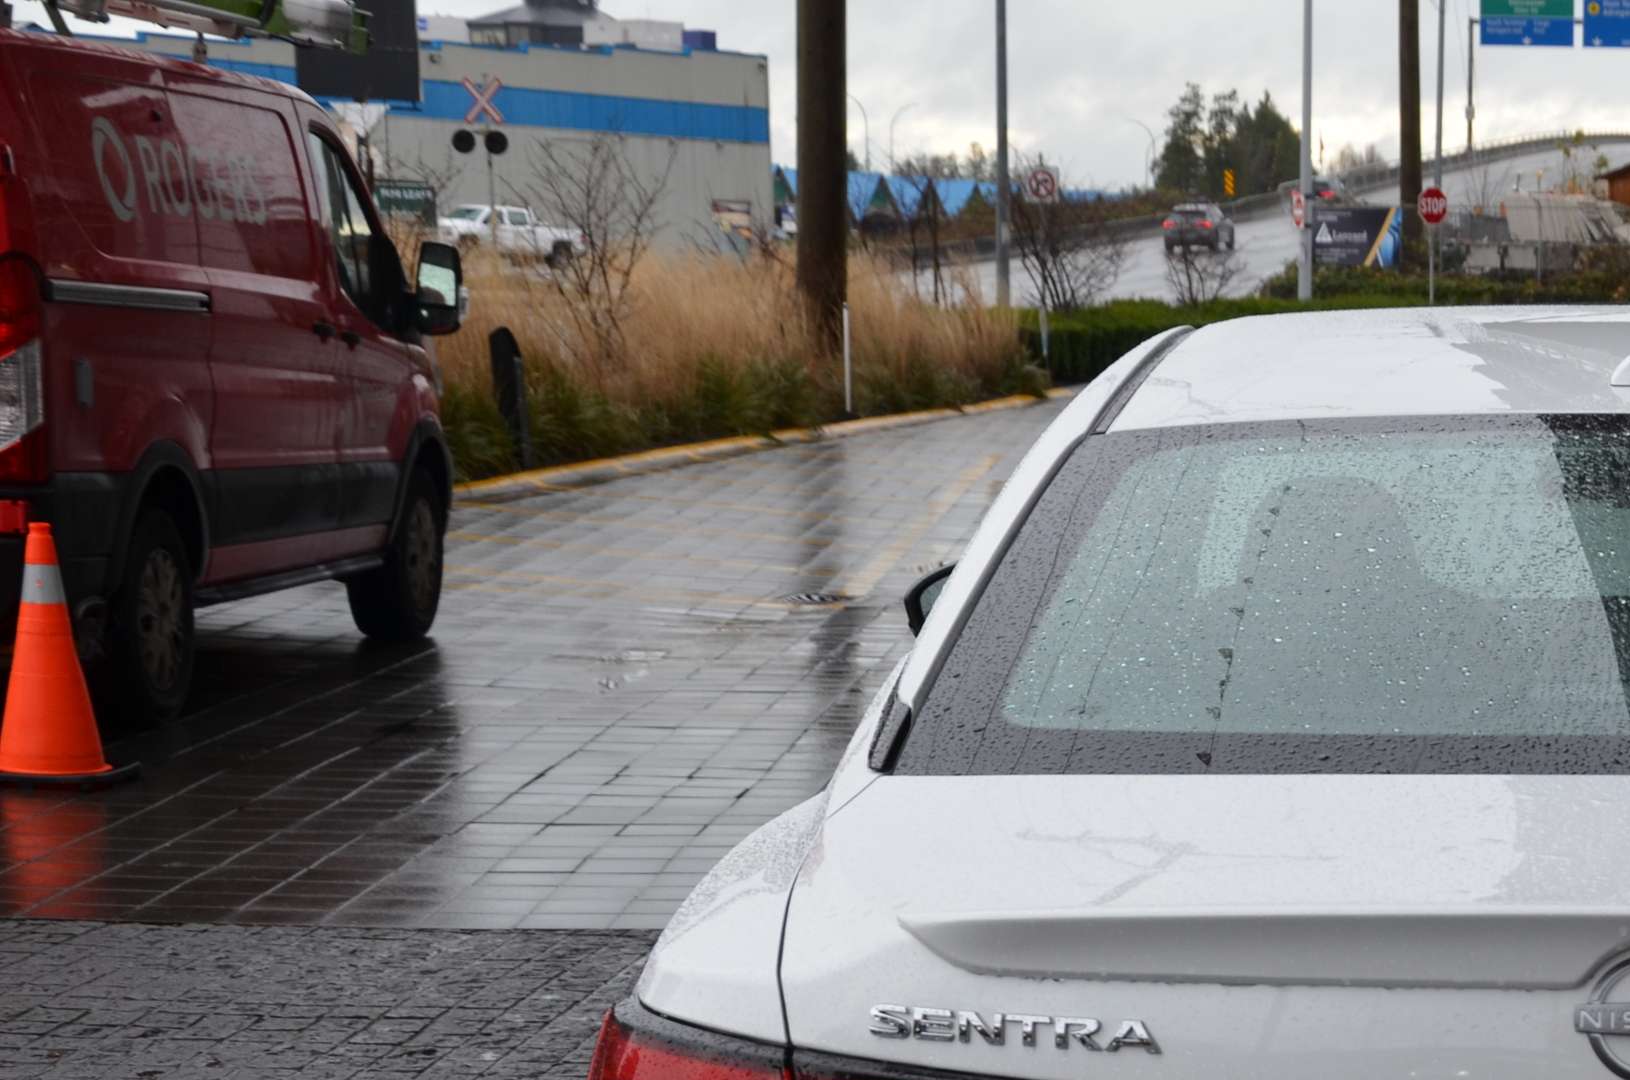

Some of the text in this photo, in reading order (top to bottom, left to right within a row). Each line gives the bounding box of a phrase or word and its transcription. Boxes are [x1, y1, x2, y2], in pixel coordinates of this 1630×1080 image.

[134, 134, 267, 225] ROGERS
[1419, 197, 1446, 214] STOP
[869, 1003, 1162, 1055] SENTRA
